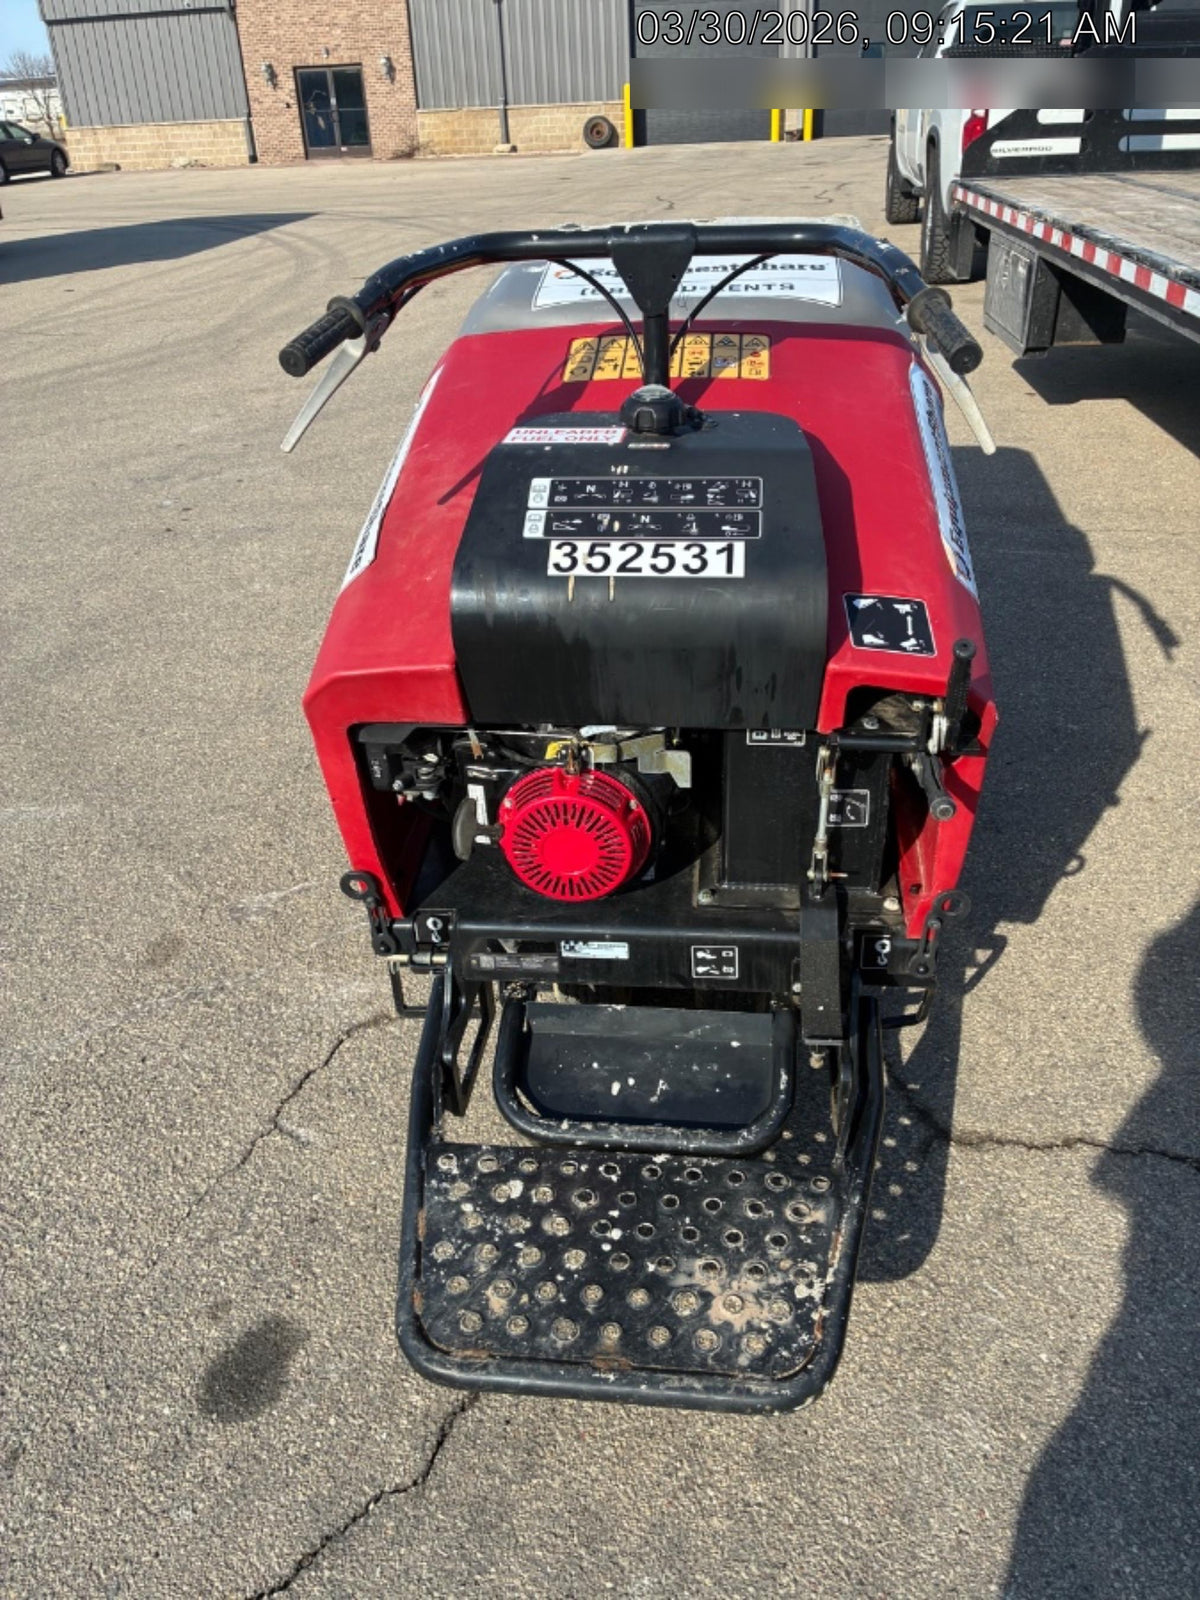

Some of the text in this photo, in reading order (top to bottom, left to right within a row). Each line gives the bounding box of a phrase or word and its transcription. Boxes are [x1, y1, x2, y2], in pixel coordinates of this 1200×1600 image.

[585, 484, 597, 493] N
[640, 514, 651, 524] N
[551, 540, 736, 575] 352531
